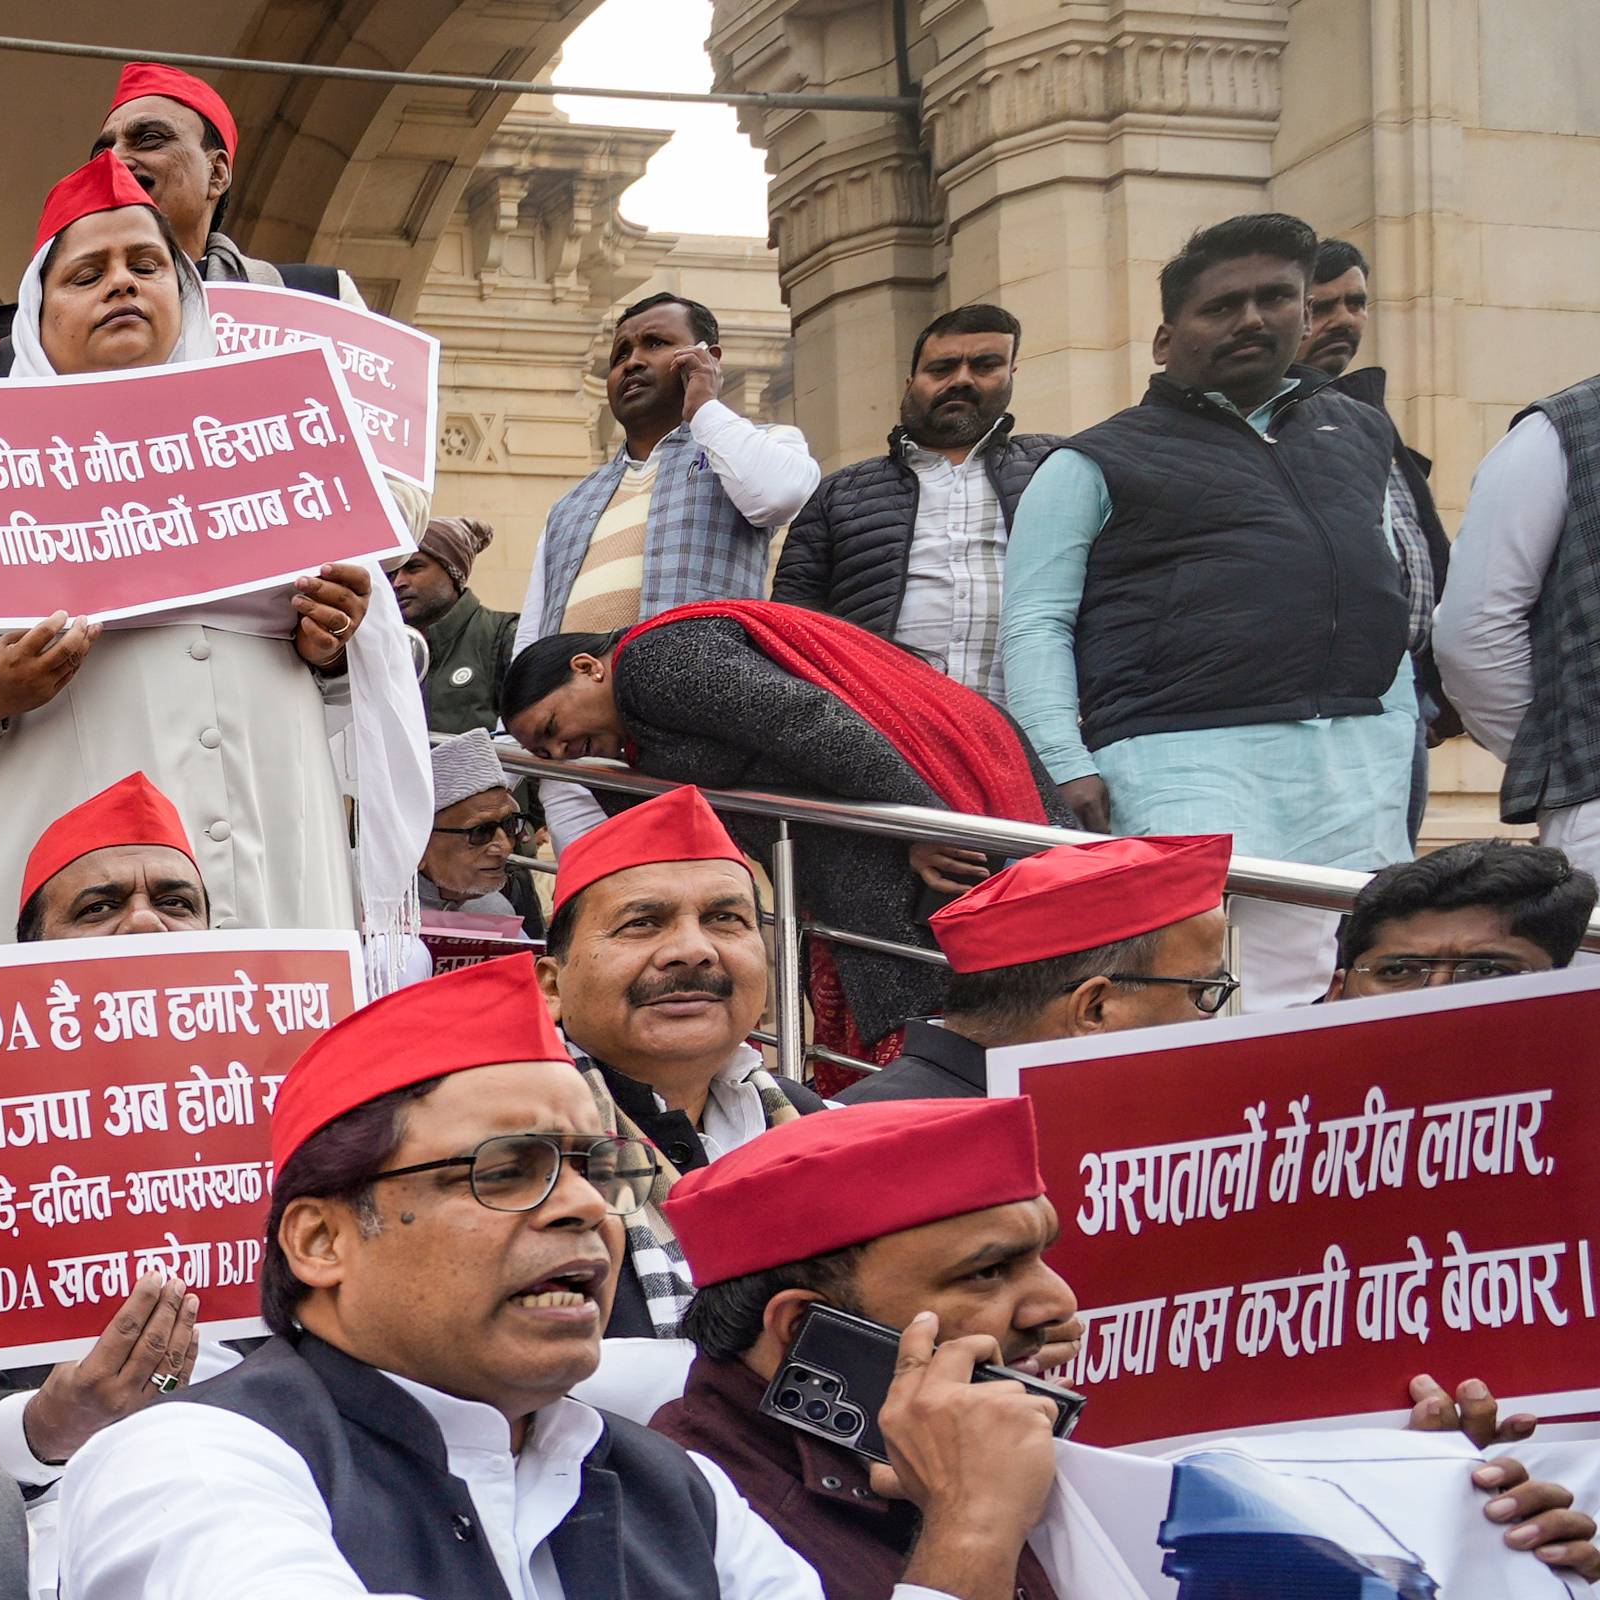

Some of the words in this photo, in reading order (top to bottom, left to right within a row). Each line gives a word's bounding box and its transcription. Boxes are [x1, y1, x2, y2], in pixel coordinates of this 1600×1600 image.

[46, 436, 79, 489] से
[80, 431, 144, 482] मौत
[145, 433, 194, 473] का
[193, 415, 294, 468] हिसाब
[293, 398, 345, 447] दो,
[198, 489, 288, 539] जवाब
[47, 979, 81, 1050] है
[94, 989, 158, 1041] अब
[165, 970, 259, 1041] हमारे
[104, 1083, 168, 1136] अब
[175, 1061, 254, 1134] होगी
[1077, 1101, 1267, 1235] अस्पतालों
[1269, 1095, 1311, 1203] में
[1312, 1086, 1415, 1198] गरीब
[1418, 1089, 1553, 1188] लाचार,
[48, 1252, 129, 1307] खत्म
[216, 1239, 260, 1285] BJP
[1169, 1287, 1234, 1371] बस
[1236, 1245, 1350, 1357] करती
[1357, 1236, 1432, 1344] वादे
